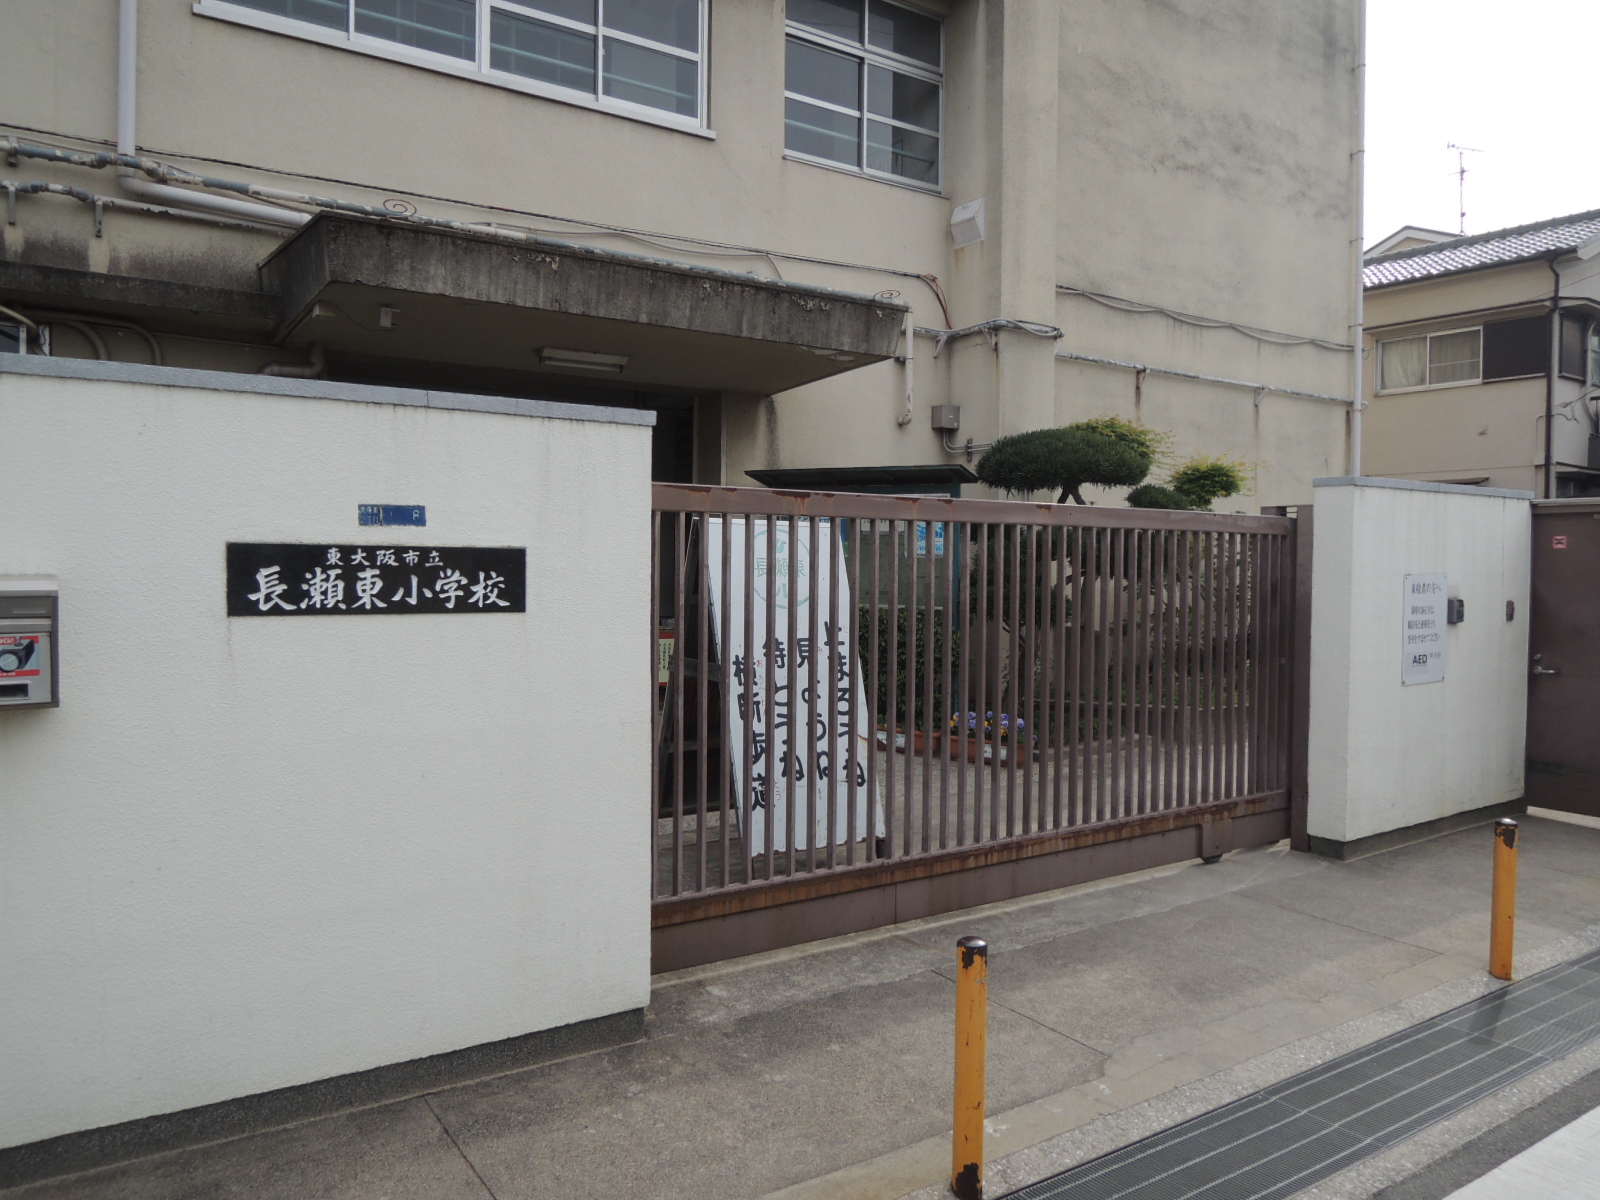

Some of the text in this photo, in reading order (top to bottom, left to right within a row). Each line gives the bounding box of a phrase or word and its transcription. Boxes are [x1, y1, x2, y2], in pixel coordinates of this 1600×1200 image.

[325, 548, 444, 567] 東大阪市立
[247, 564, 511, 611] 長瀬東小学校
[1412, 654, 1428, 664] AED
